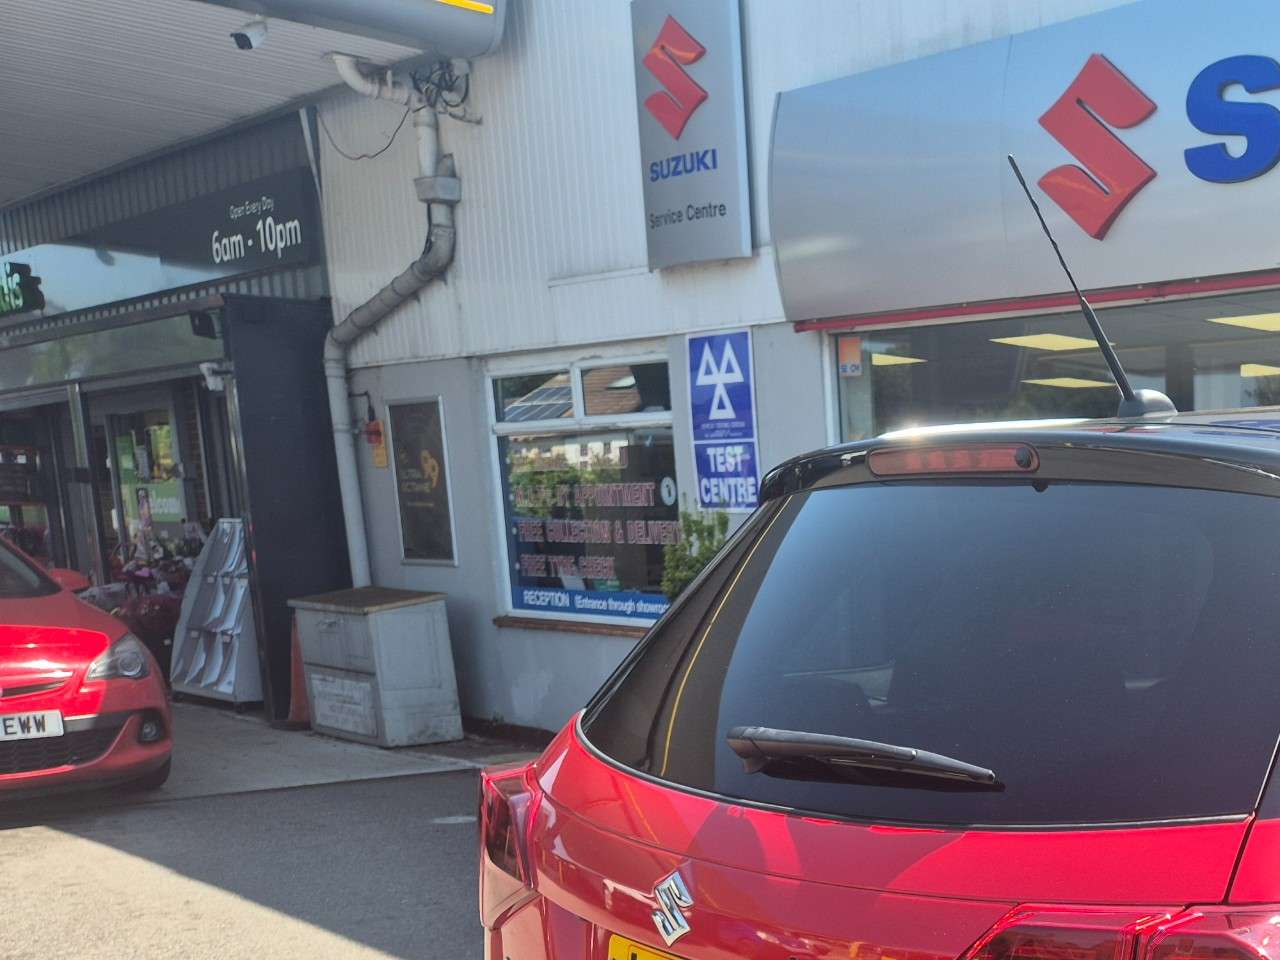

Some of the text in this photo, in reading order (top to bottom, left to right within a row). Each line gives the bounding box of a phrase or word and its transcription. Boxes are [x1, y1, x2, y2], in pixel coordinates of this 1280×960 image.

[649, 148, 718, 183] SUZUKI
[650, 203, 727, 230] Service Centre
[212, 230, 245, 264] 6am
[256, 216, 302, 259] 10pm
[706, 445, 744, 473] TEST
[573, 481, 656, 507] APPOINTMENT
[700, 476, 758, 504] CENTRE
[519, 519, 545, 543] FREE
[546, 519, 612, 544] COLLECTION
[520, 553, 547, 577] FREE
[523, 590, 570, 608] RECEPTION
[608, 597, 636, 615] through
[3, 714, 46, 736] EWW
